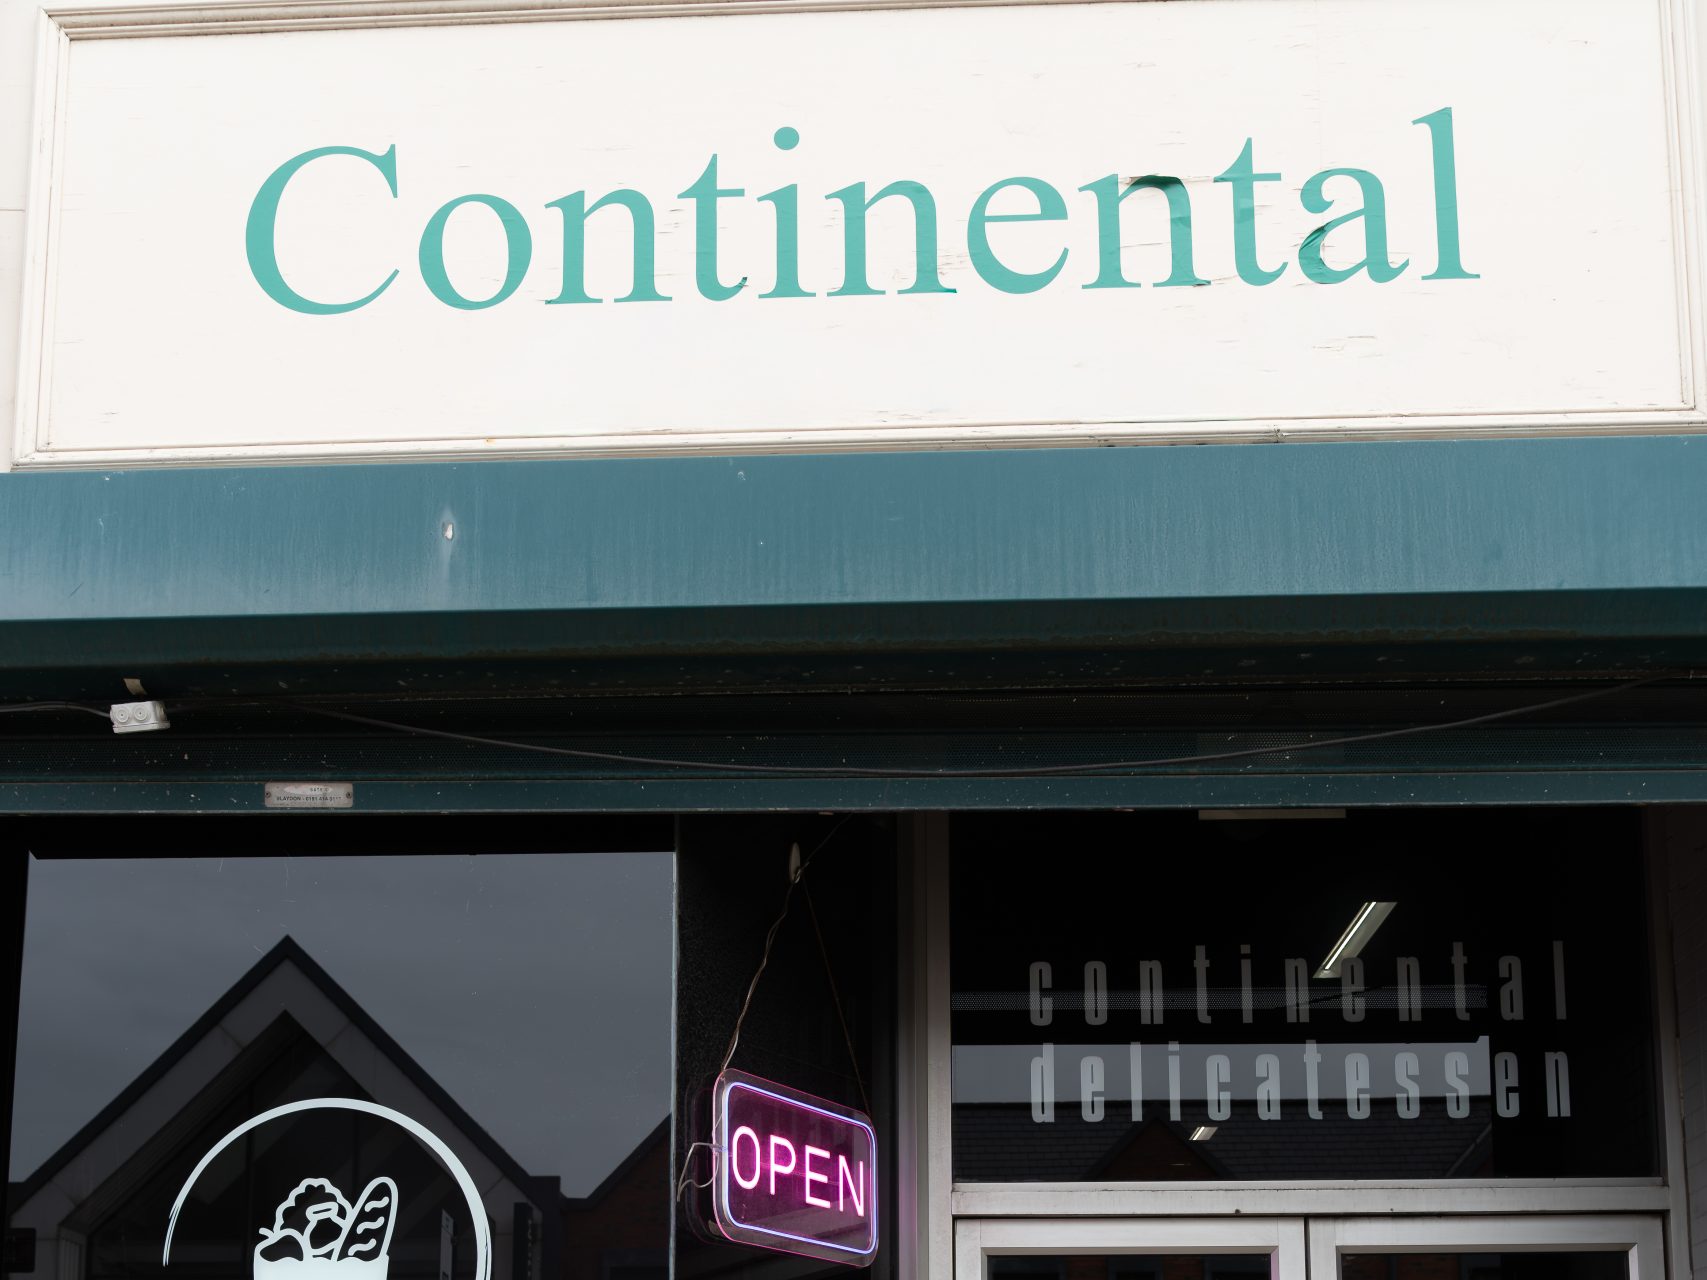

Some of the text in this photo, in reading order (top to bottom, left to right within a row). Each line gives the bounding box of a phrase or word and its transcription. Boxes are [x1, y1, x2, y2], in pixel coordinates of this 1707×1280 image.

[245, 107, 1481, 315] Continental
[1029, 940, 1567, 1026] continental
[1030, 1040, 1571, 1123] delicatessen
[733, 1126, 865, 1217] OPEN
